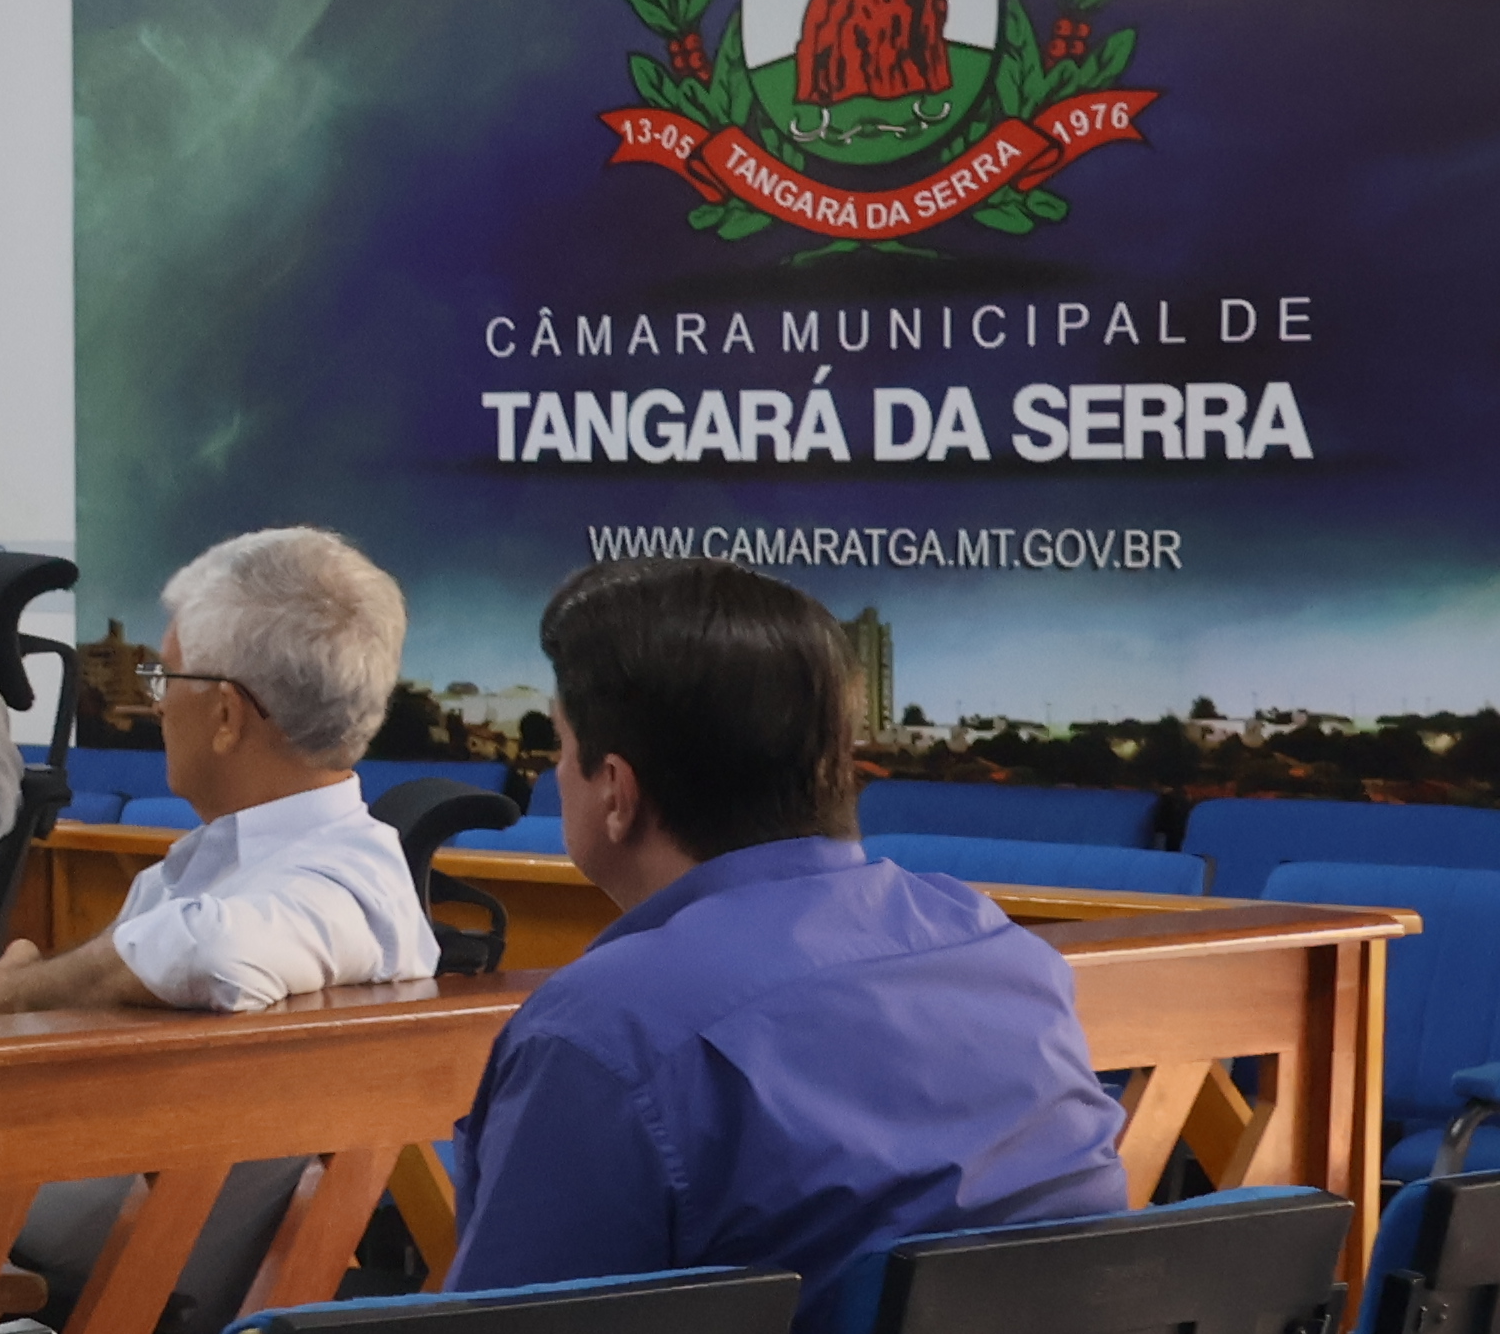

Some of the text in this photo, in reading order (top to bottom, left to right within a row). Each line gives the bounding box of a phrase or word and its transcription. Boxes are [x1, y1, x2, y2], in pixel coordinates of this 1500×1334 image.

[621, 119, 694, 160] 13-05
[1052, 102, 1131, 147] 1976
[725, 140, 1022, 230] TANGARÁ DA SERRA
[485, 297, 1313, 357] CÂMARA MUNICIPAL DE
[481, 365, 1314, 463] TANGARÁ DA SERRA
[589, 526, 1183, 569] WWWCAMARATGA.MT.GOV.BR
